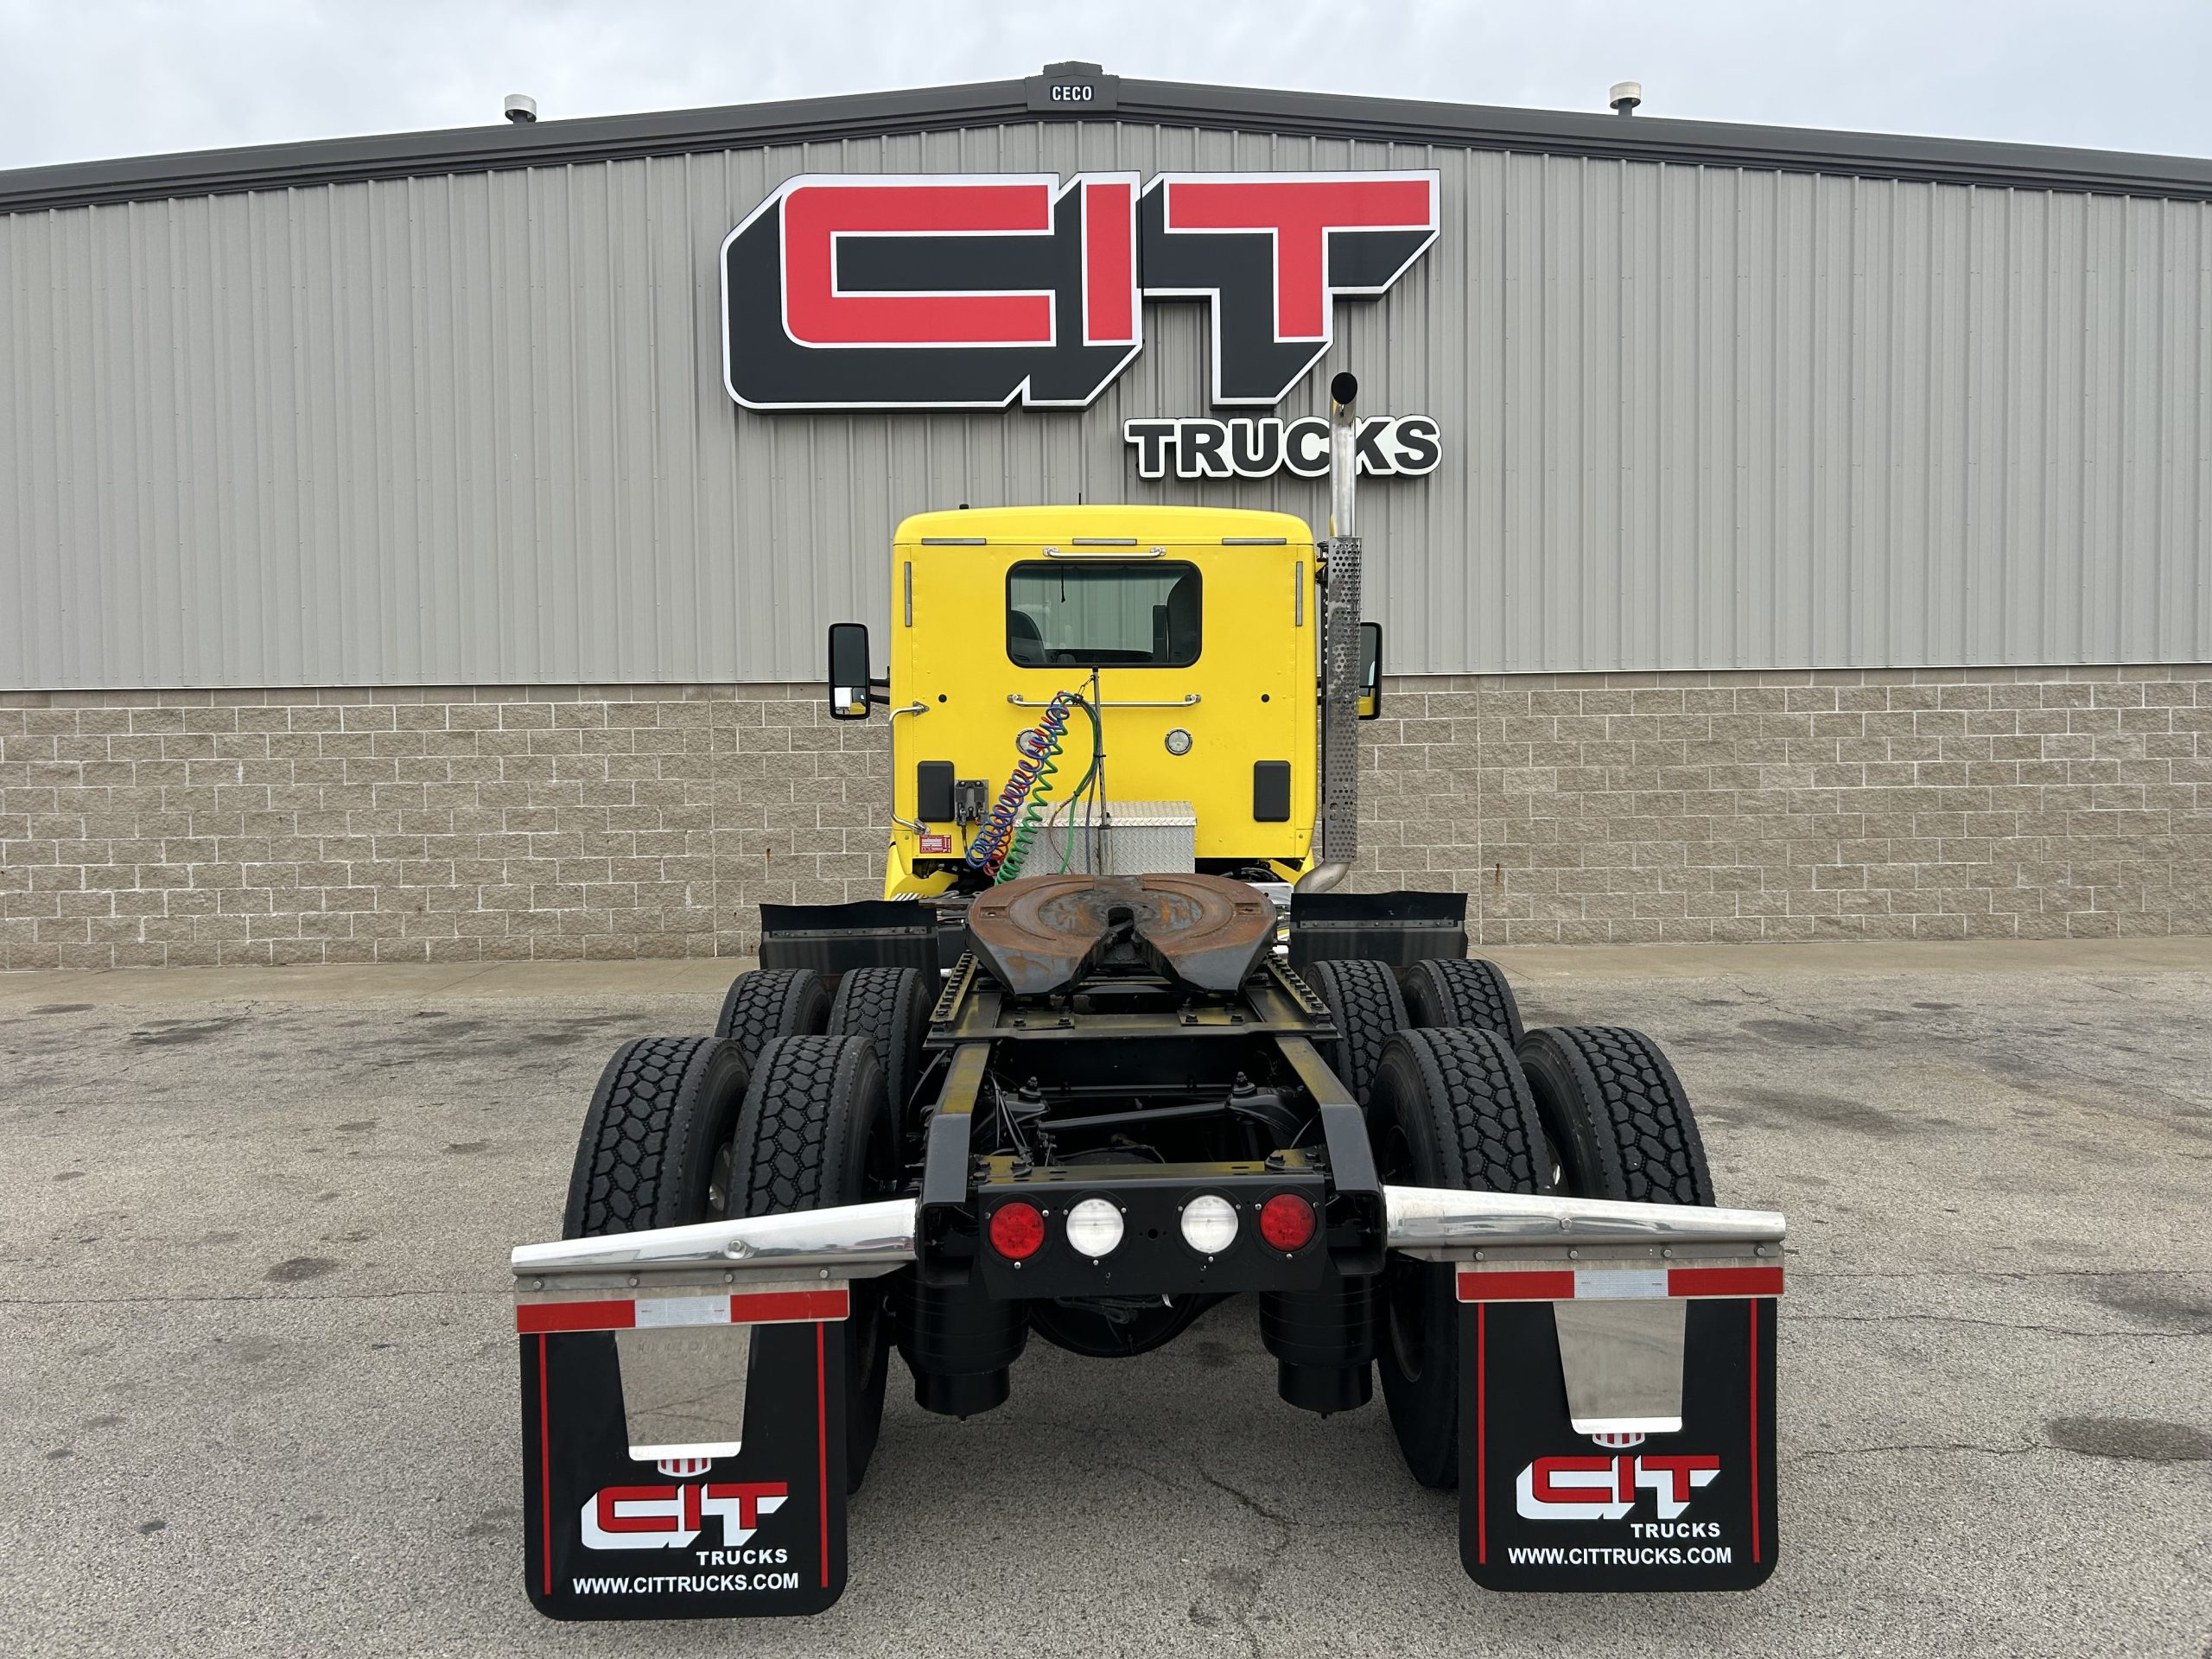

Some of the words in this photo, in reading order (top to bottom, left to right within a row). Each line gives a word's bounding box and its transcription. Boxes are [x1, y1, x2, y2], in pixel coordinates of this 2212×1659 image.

[1052, 86, 1092, 101] CECO
[721, 170, 1440, 410] CIT
[1125, 416, 1441, 477] TRUCKS
[1516, 1455, 1720, 1519] CIT
[582, 1482, 788, 1549] CIT
[1630, 1522, 1720, 1538] TRUCKS
[696, 1548, 788, 1566] TRUCKS
[1508, 1547, 1732, 1565] WWW.CITTRUCKS.COM
[573, 1573, 799, 1594] WWW.CITTRUCKS.COM
